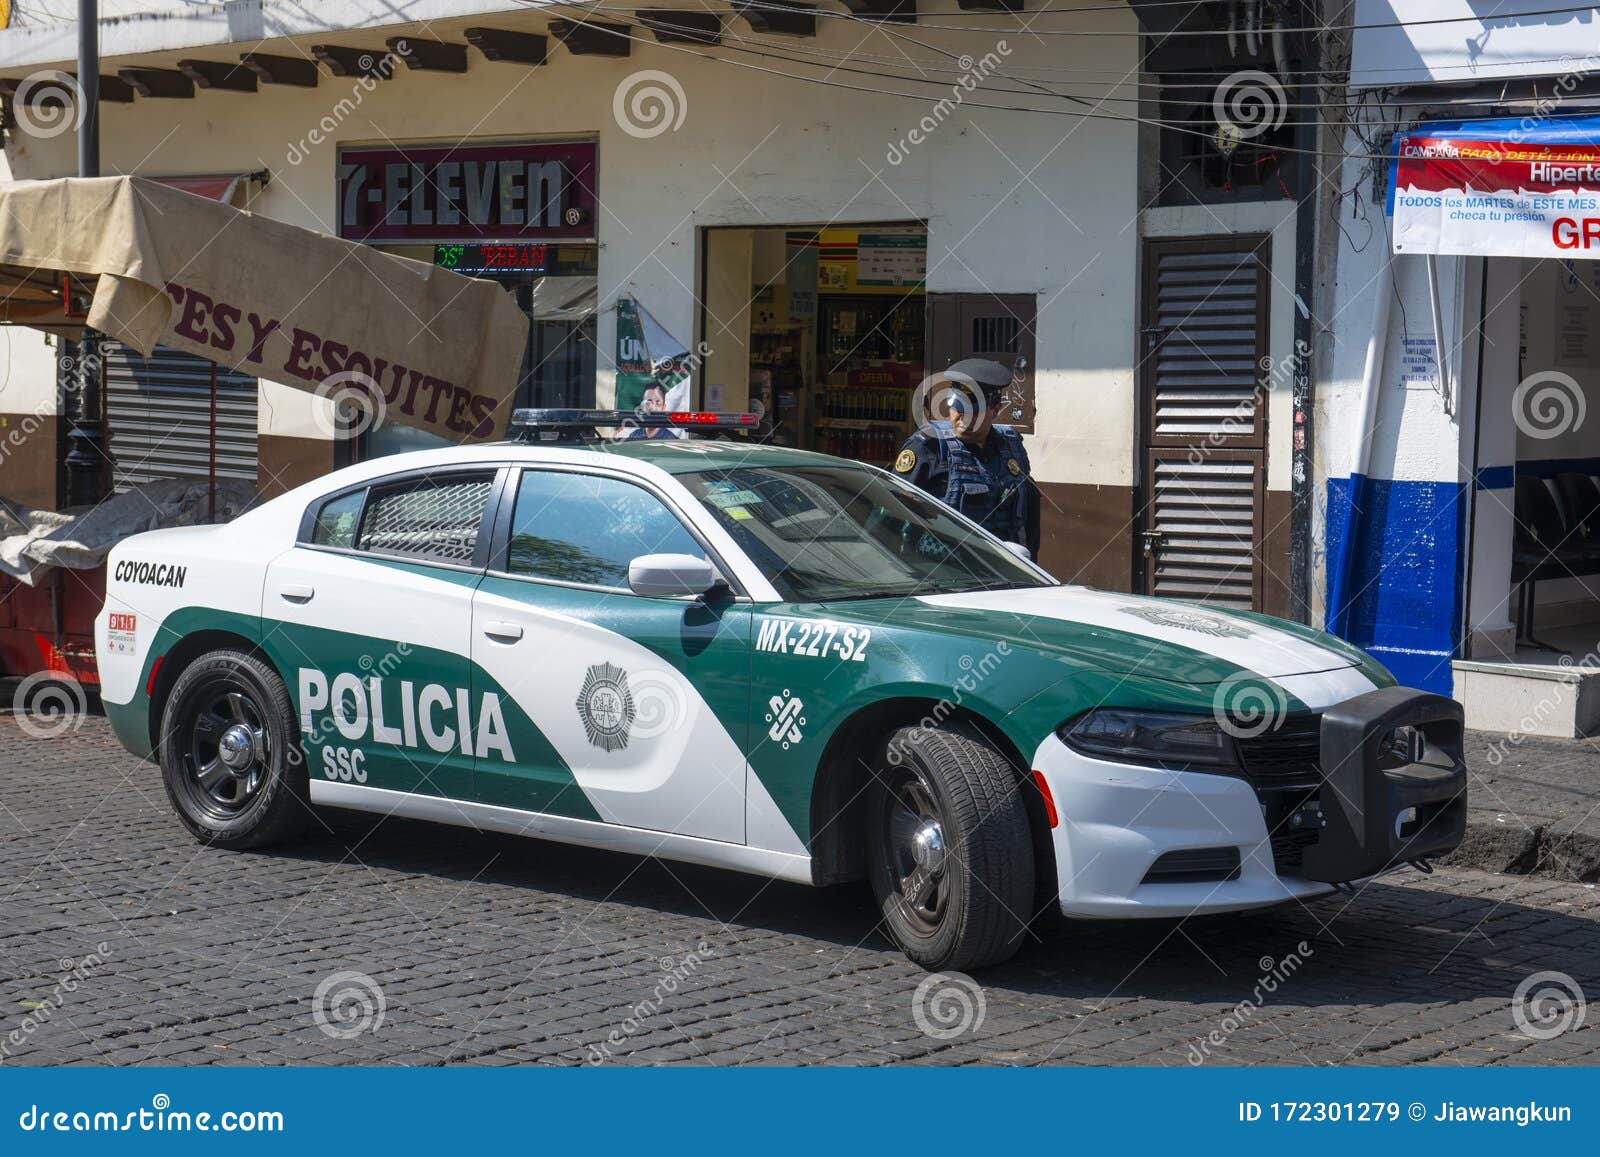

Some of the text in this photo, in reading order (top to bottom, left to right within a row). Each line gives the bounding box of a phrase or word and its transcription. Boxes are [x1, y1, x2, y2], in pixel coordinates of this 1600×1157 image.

[1404, 144, 1459, 159] CAMPAÑA
[1460, 149, 1501, 159] PARA
[1399, 196, 1443, 208] TODOS
[1445, 197, 1463, 208] los
[1466, 197, 1514, 209] MARTES
[1517, 199, 1530, 210] de
[1533, 198, 1564, 210] ESTE
[1450, 211, 1546, 223] checa tu presión
[246, 312, 281, 363] Y
[283, 327, 499, 439] ESQUITES
[115, 560, 187, 588] COYOACAN
[110, 614, 136, 630] 911
[755, 619, 872, 662] MX-227-S2
[298, 667, 517, 763] POLICIA
[322, 745, 368, 783] SSC
